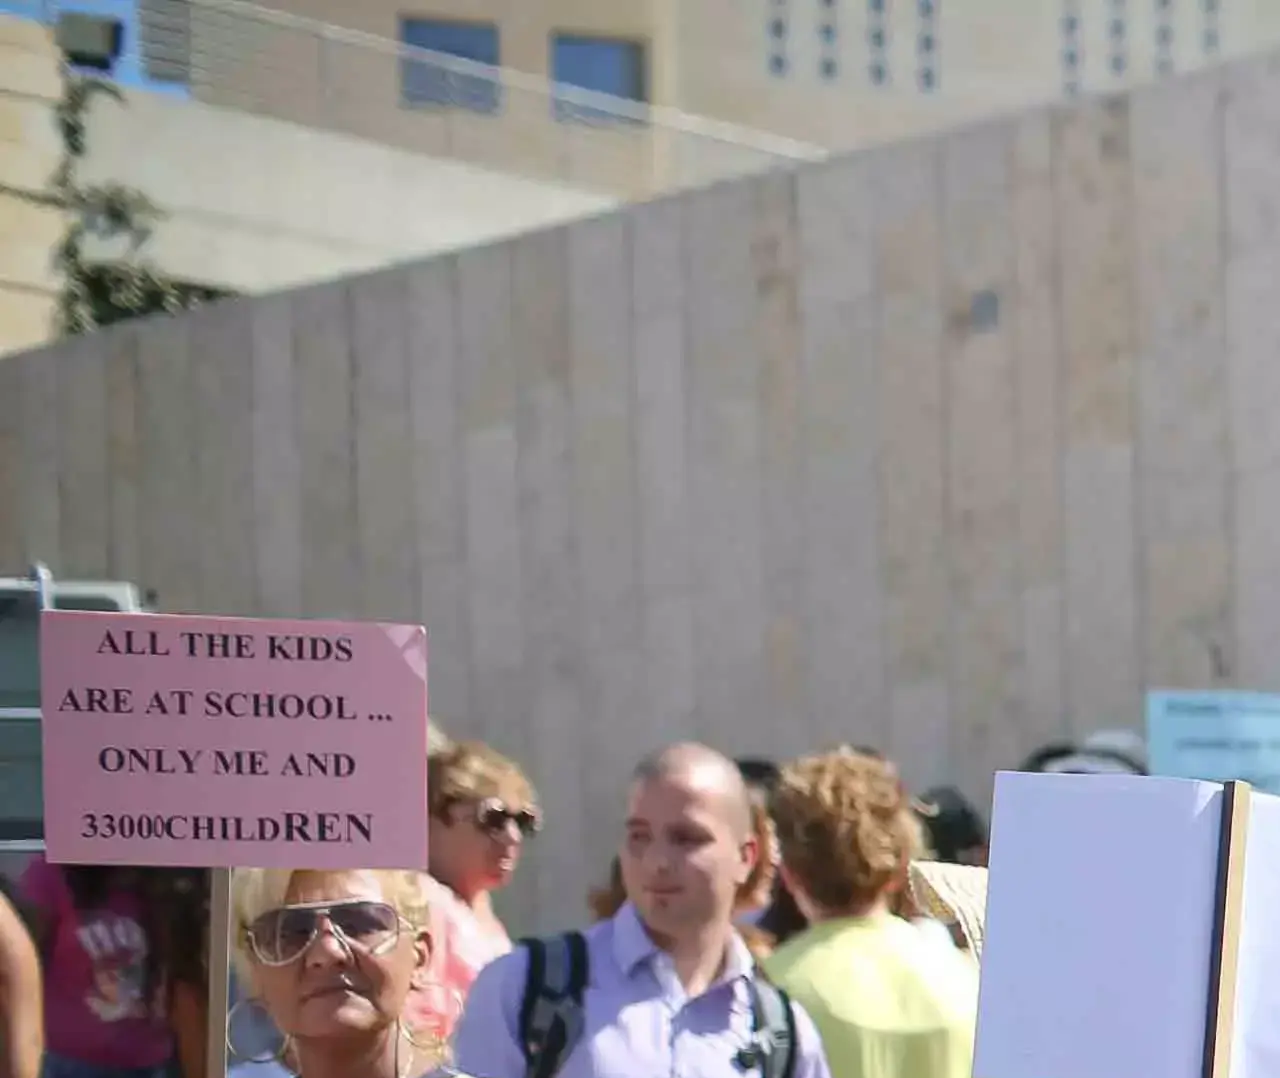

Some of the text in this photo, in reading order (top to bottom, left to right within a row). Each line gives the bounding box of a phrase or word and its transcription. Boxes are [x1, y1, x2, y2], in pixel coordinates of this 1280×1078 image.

[97, 630, 354, 662] ALL THE KIDS
[58, 688, 134, 715] ARE
[144, 690, 195, 716] AT
[204, 691, 357, 721] SCHOOL
[98, 747, 357, 778] ONLY ME AND
